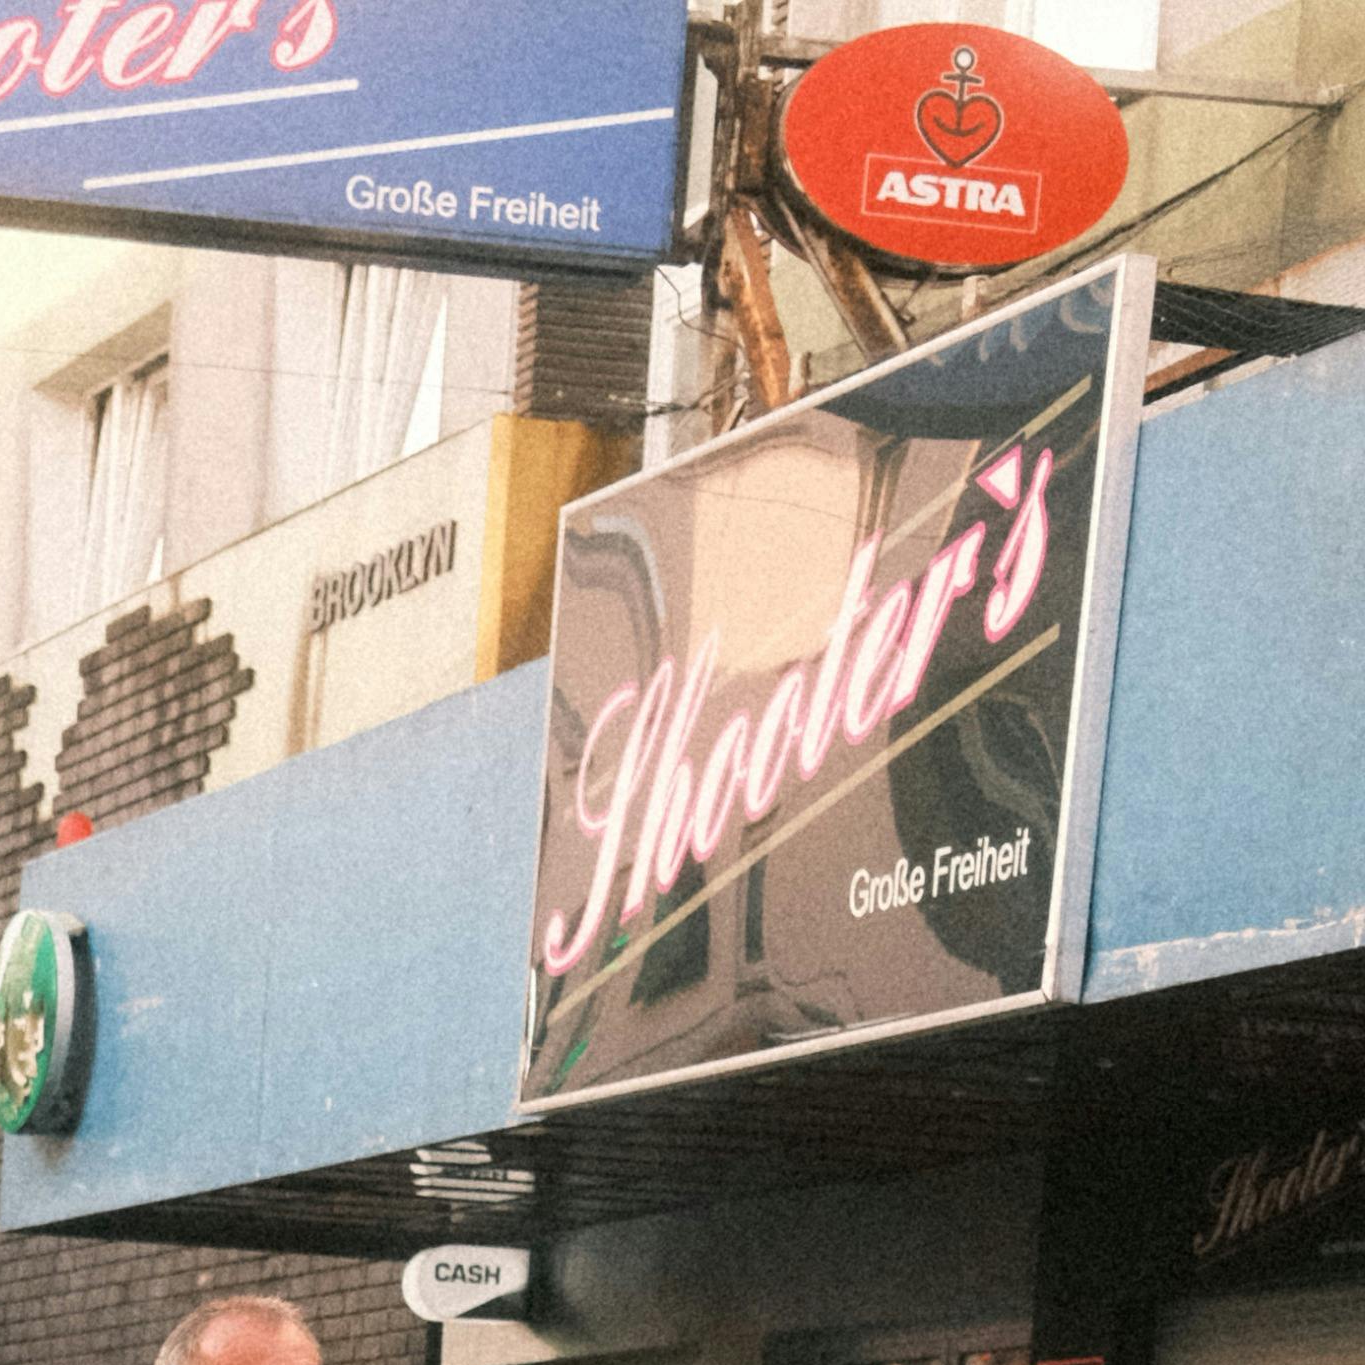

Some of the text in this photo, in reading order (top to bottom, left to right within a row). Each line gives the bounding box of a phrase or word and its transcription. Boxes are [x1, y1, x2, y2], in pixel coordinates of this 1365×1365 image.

[345, 174, 602, 233] Große Freiheit
[876, 171, 1027, 219] ASTRA
[310, 519, 457, 634] BROOKLYN
[543, 446, 1053, 976] Shooter's
[848, 827, 1032, 920] Große Freiheit
[1192, 1118, 1365, 1257] Shooter
[434, 1261, 502, 1286] CASH
